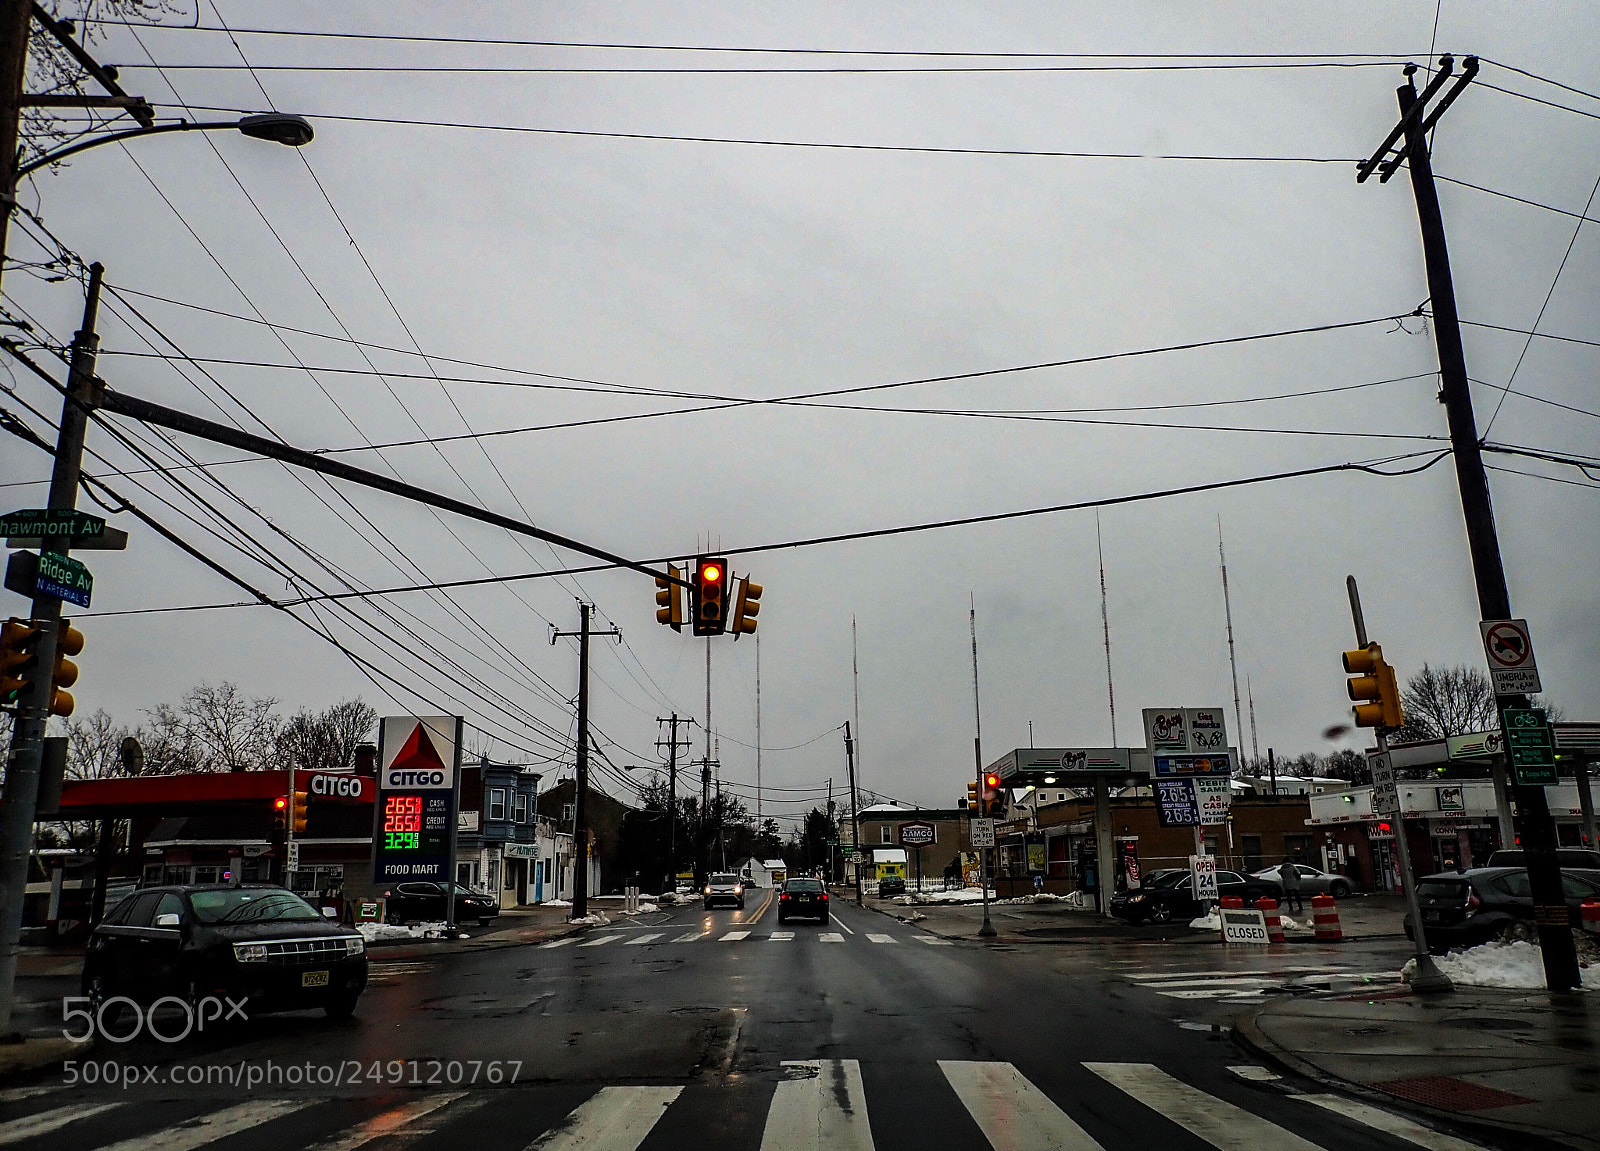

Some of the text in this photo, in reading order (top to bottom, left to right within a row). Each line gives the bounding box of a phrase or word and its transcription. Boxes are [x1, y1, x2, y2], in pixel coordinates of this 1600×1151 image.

[82, 520, 102, 534] Av
[40, 557, 92, 590] Ridge Av
[36, 578, 89, 606] N ARTERIAL S
[1496, 672, 1528, 682] UMBRIA
[1376, 760, 1384, 769] NO
[389, 772, 444, 786] CITGO
[1375, 772, 1390, 782] TURN
[311, 775, 362, 797] CITGO
[1375, 782, 1394, 794] ON RED
[1160, 788, 1188, 802] 2.65
[1165, 809, 1192, 823] 2.65
[385, 864, 439, 874] FOOD MART
[1196, 861, 1215, 872] OPEN
[1200, 874, 1214, 888] 24
[1227, 928, 1265, 938] CLOSED
